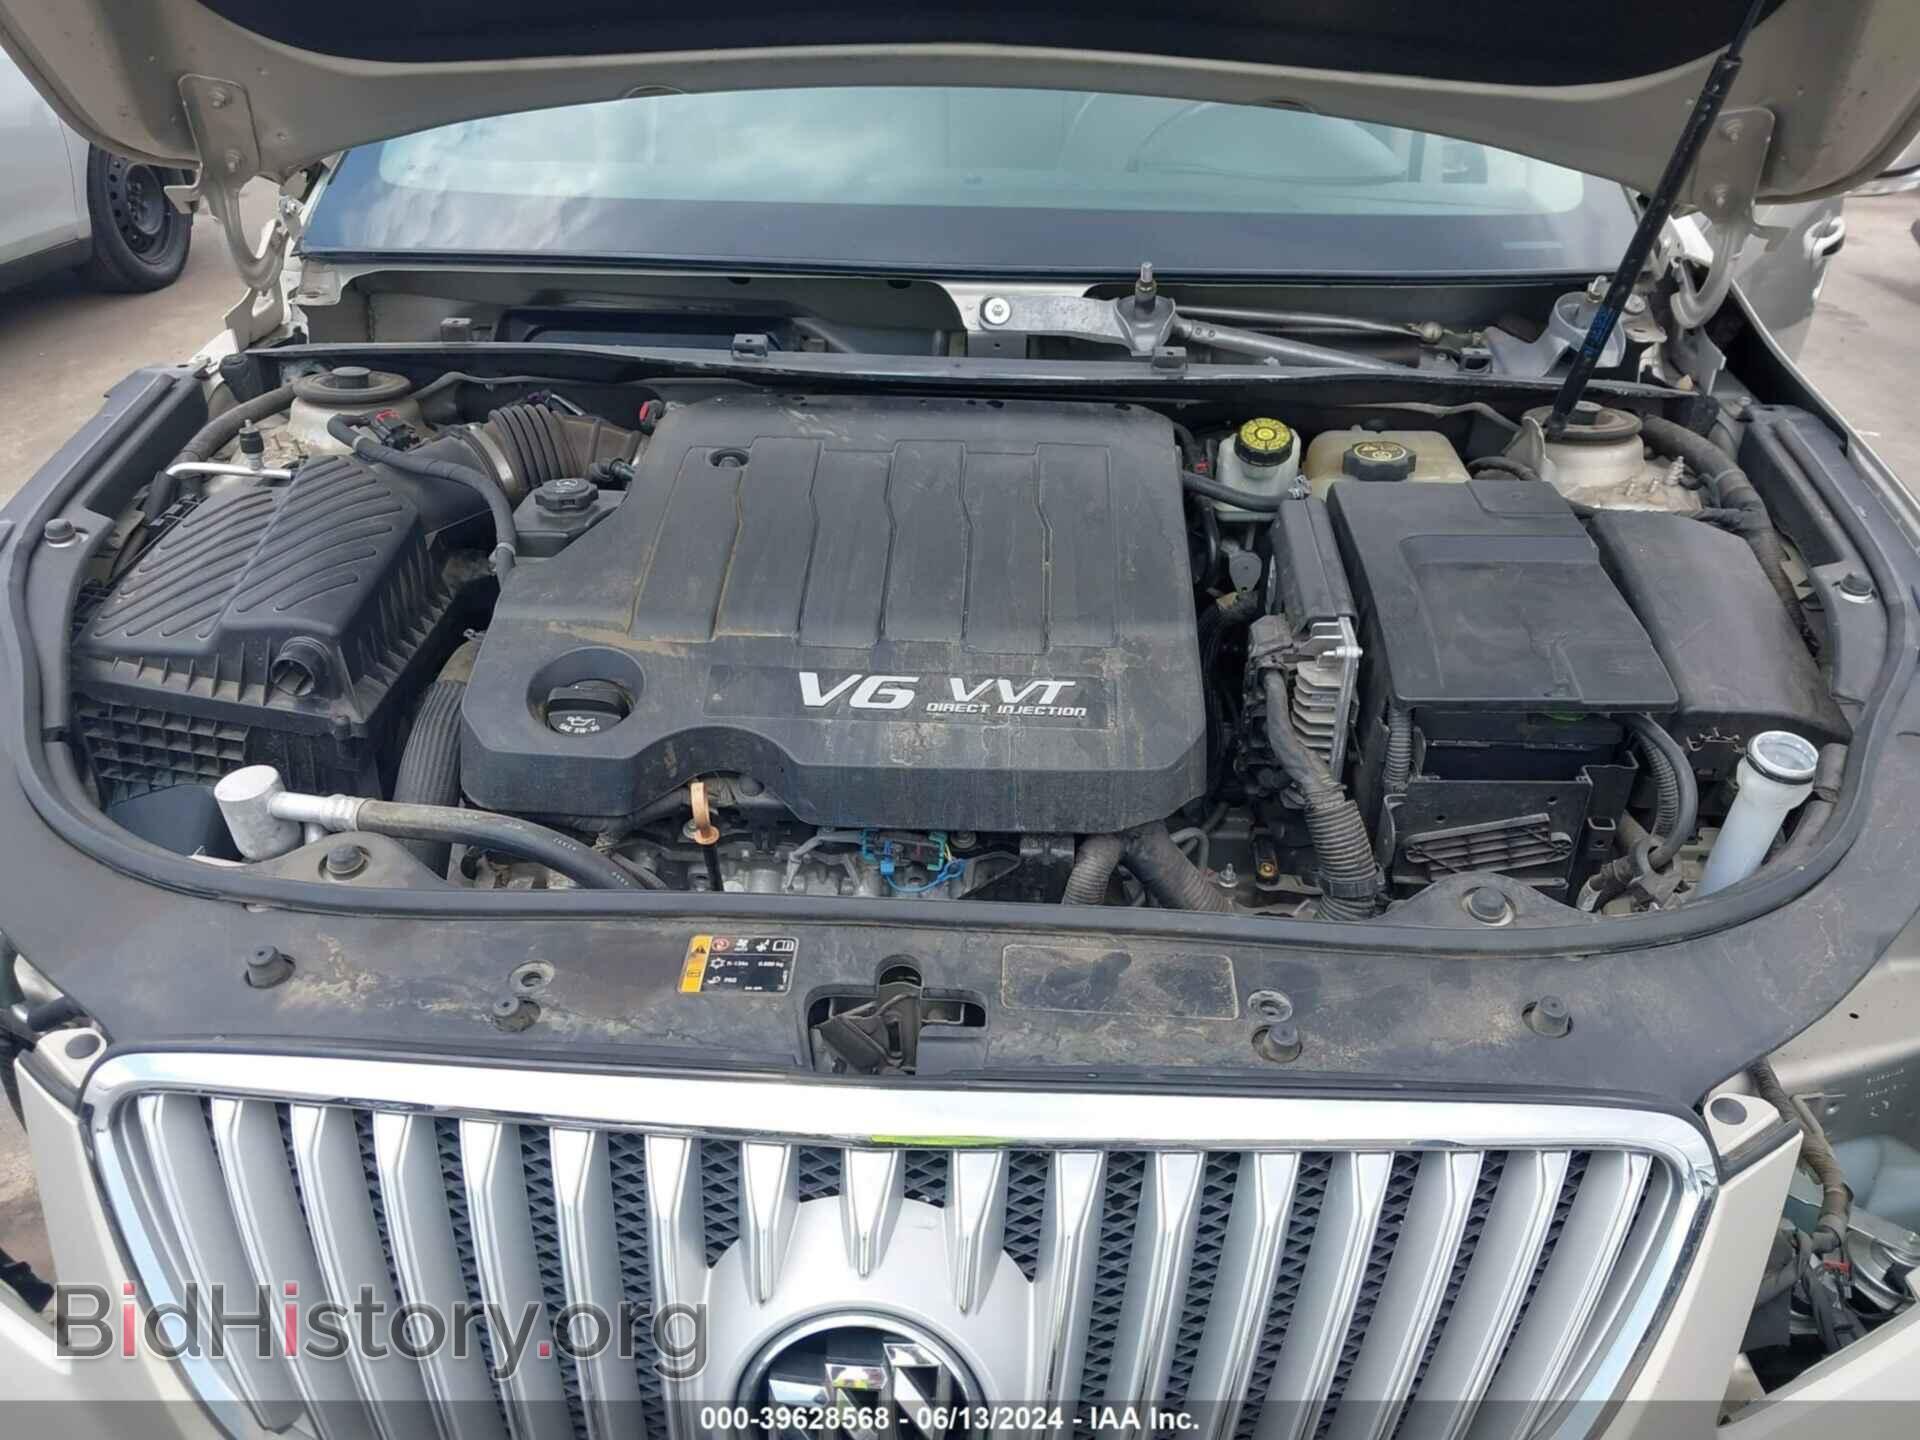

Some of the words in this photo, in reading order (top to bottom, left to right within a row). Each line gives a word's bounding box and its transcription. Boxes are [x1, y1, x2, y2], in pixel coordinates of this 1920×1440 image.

[798, 671, 920, 709] V6
[949, 677, 1076, 704] VVT
[926, 702, 991, 714] DIRECT
[996, 704, 1087, 717] INJECTION
